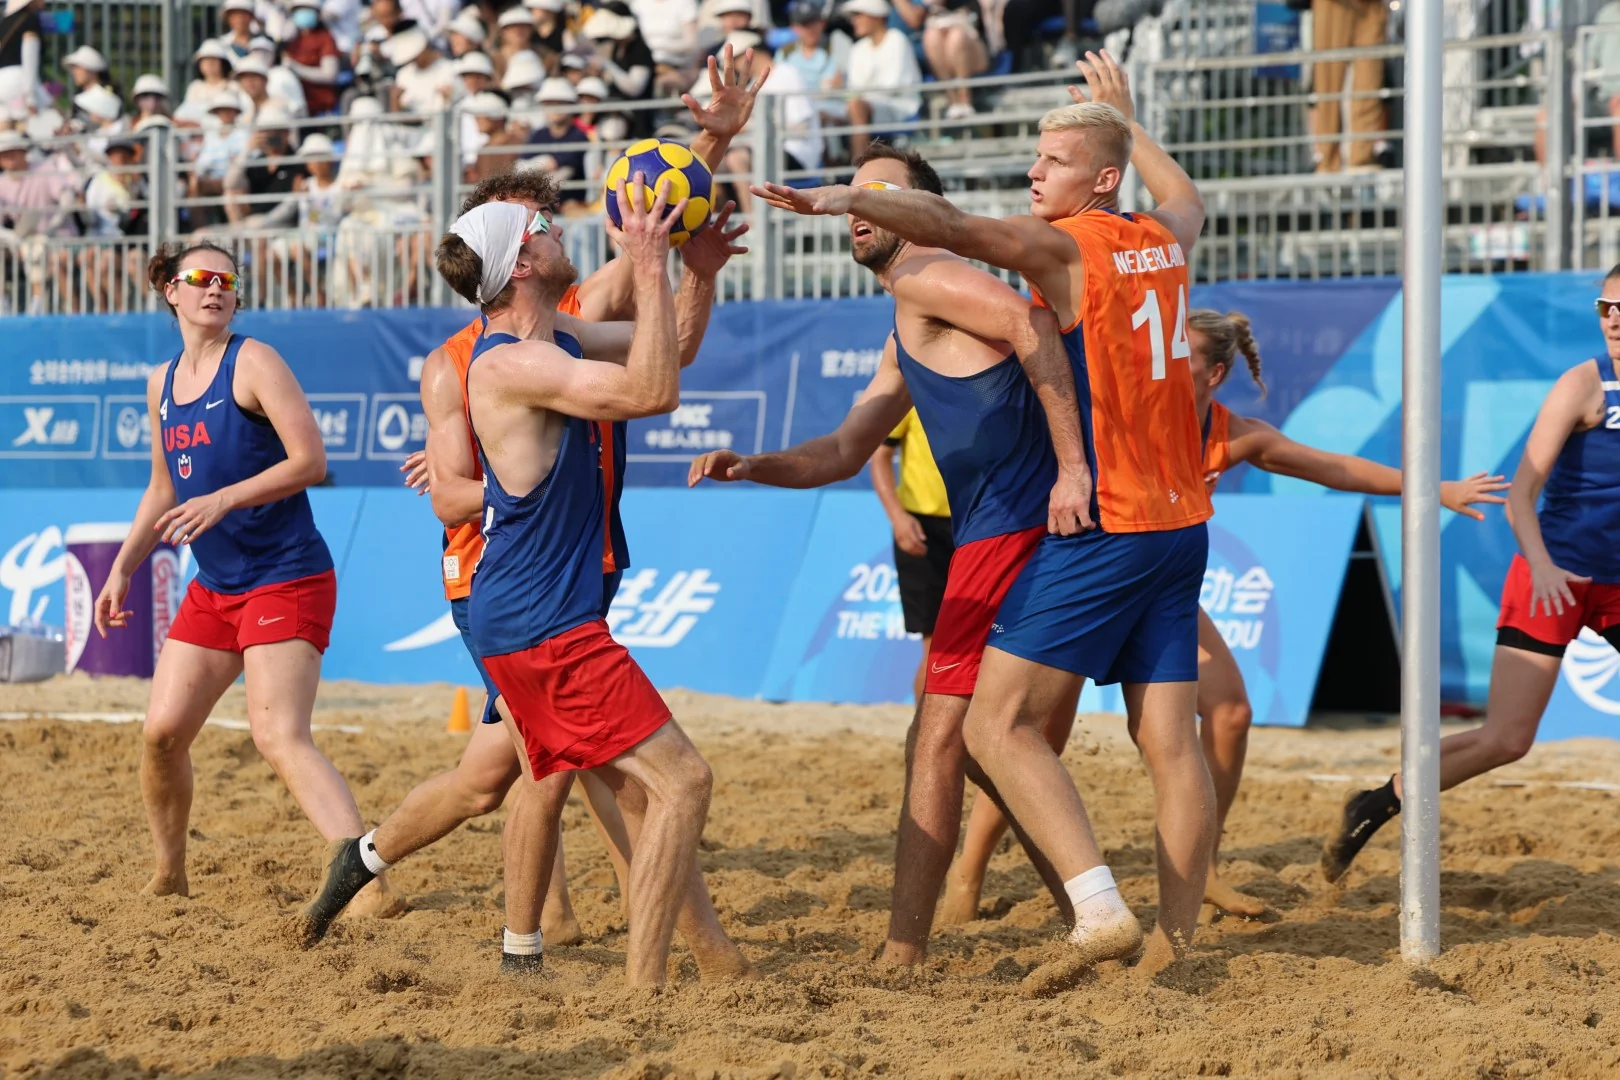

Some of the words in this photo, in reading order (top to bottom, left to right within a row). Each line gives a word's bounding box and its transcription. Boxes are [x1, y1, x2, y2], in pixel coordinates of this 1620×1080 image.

[1131, 283, 1192, 380] 14
[160, 398, 168, 420] 4
[1605, 405, 1620, 429] 2
[164, 421, 212, 452] USA
[836, 610, 883, 640] THE
